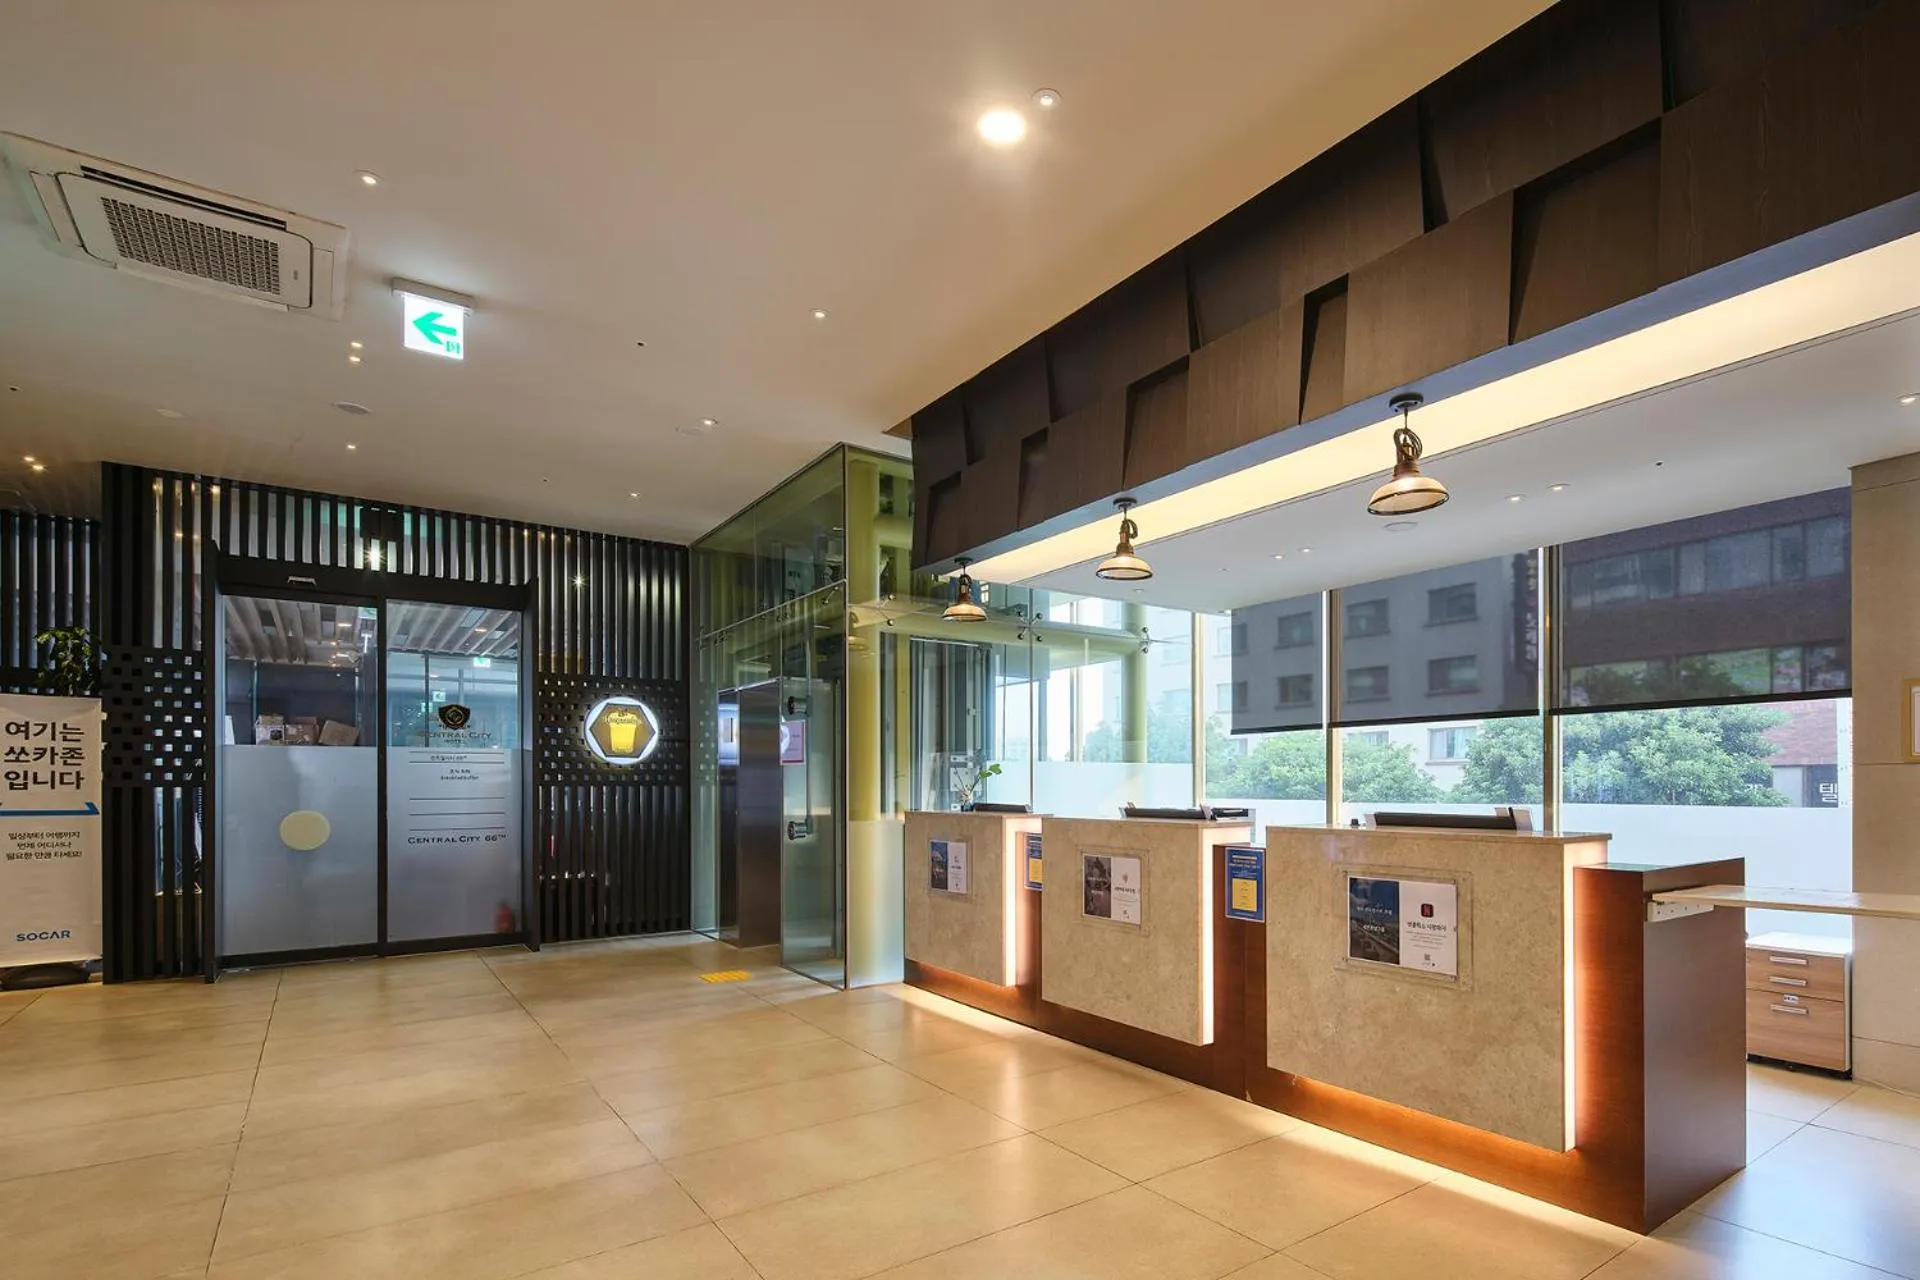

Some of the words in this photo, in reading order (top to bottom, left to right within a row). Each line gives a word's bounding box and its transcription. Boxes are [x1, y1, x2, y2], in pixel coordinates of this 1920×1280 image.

[5, 721, 85, 742] 여기는
[4, 746, 85, 766] 쏘카존
[4, 770, 85, 791] 입니다
[36, 841, 72, 849] 어디서나
[407, 836, 458, 845] CENTRAL
[459, 835, 481, 843] CITY
[16, 929, 71, 942] SOCAR
